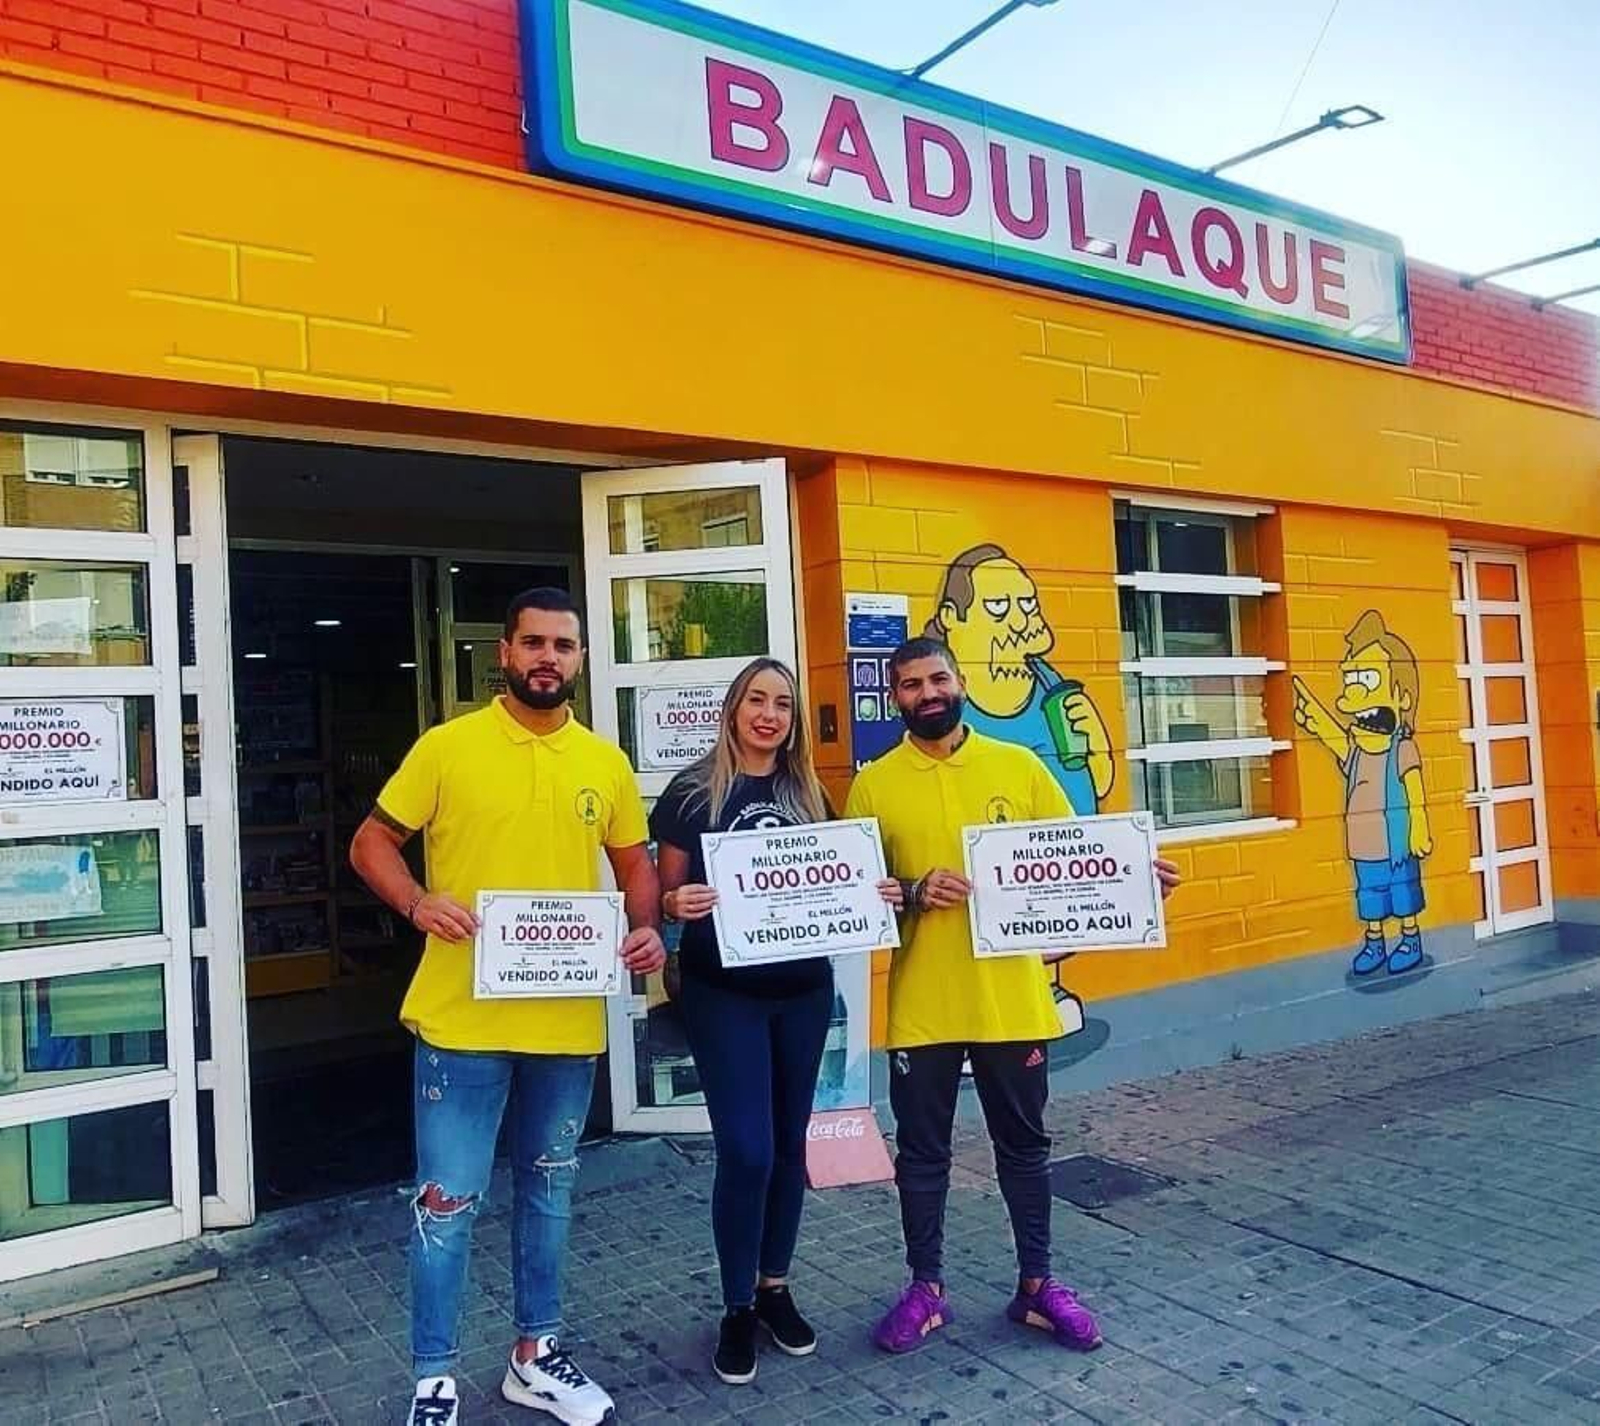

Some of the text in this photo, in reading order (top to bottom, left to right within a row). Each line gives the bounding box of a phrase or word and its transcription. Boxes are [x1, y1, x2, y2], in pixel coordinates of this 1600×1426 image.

[705, 57, 1351, 320] BADULAQUE
[678, 689, 714, 699] PREMIO
[14, 707, 64, 717] PREMIO
[0, 720, 81, 731] MILLONARIO
[95, 737, 102, 746] €
[656, 747, 707, 759] VENDIDO
[0, 776, 99, 792] NDIDO AQUÍ
[766, 835, 819, 850] PREMIO
[1028, 828, 1084, 842] PREMIO
[751, 849, 837, 869] MILLONARIO
[1012, 843, 1104, 861] MILLONARIO
[734, 862, 852, 893] 1.000.000
[856, 869, 865, 880] €
[993, 857, 1118, 887] 1.000.000
[1122, 864, 1132, 875] €
[530, 900, 573, 911] PREMIO
[808, 904, 853, 919] EL MILLÓN
[1067, 899, 1116, 913] EL MILLÓN
[515, 913, 586, 923] MILLONARIO
[999, 913, 1132, 936] VENDIDO AQUÍ
[500, 925, 594, 941] 1.000.000
[744, 917, 869, 945] VENDIDO AQUÍ
[498, 968, 598, 983] VENDIDO AQUÍ
